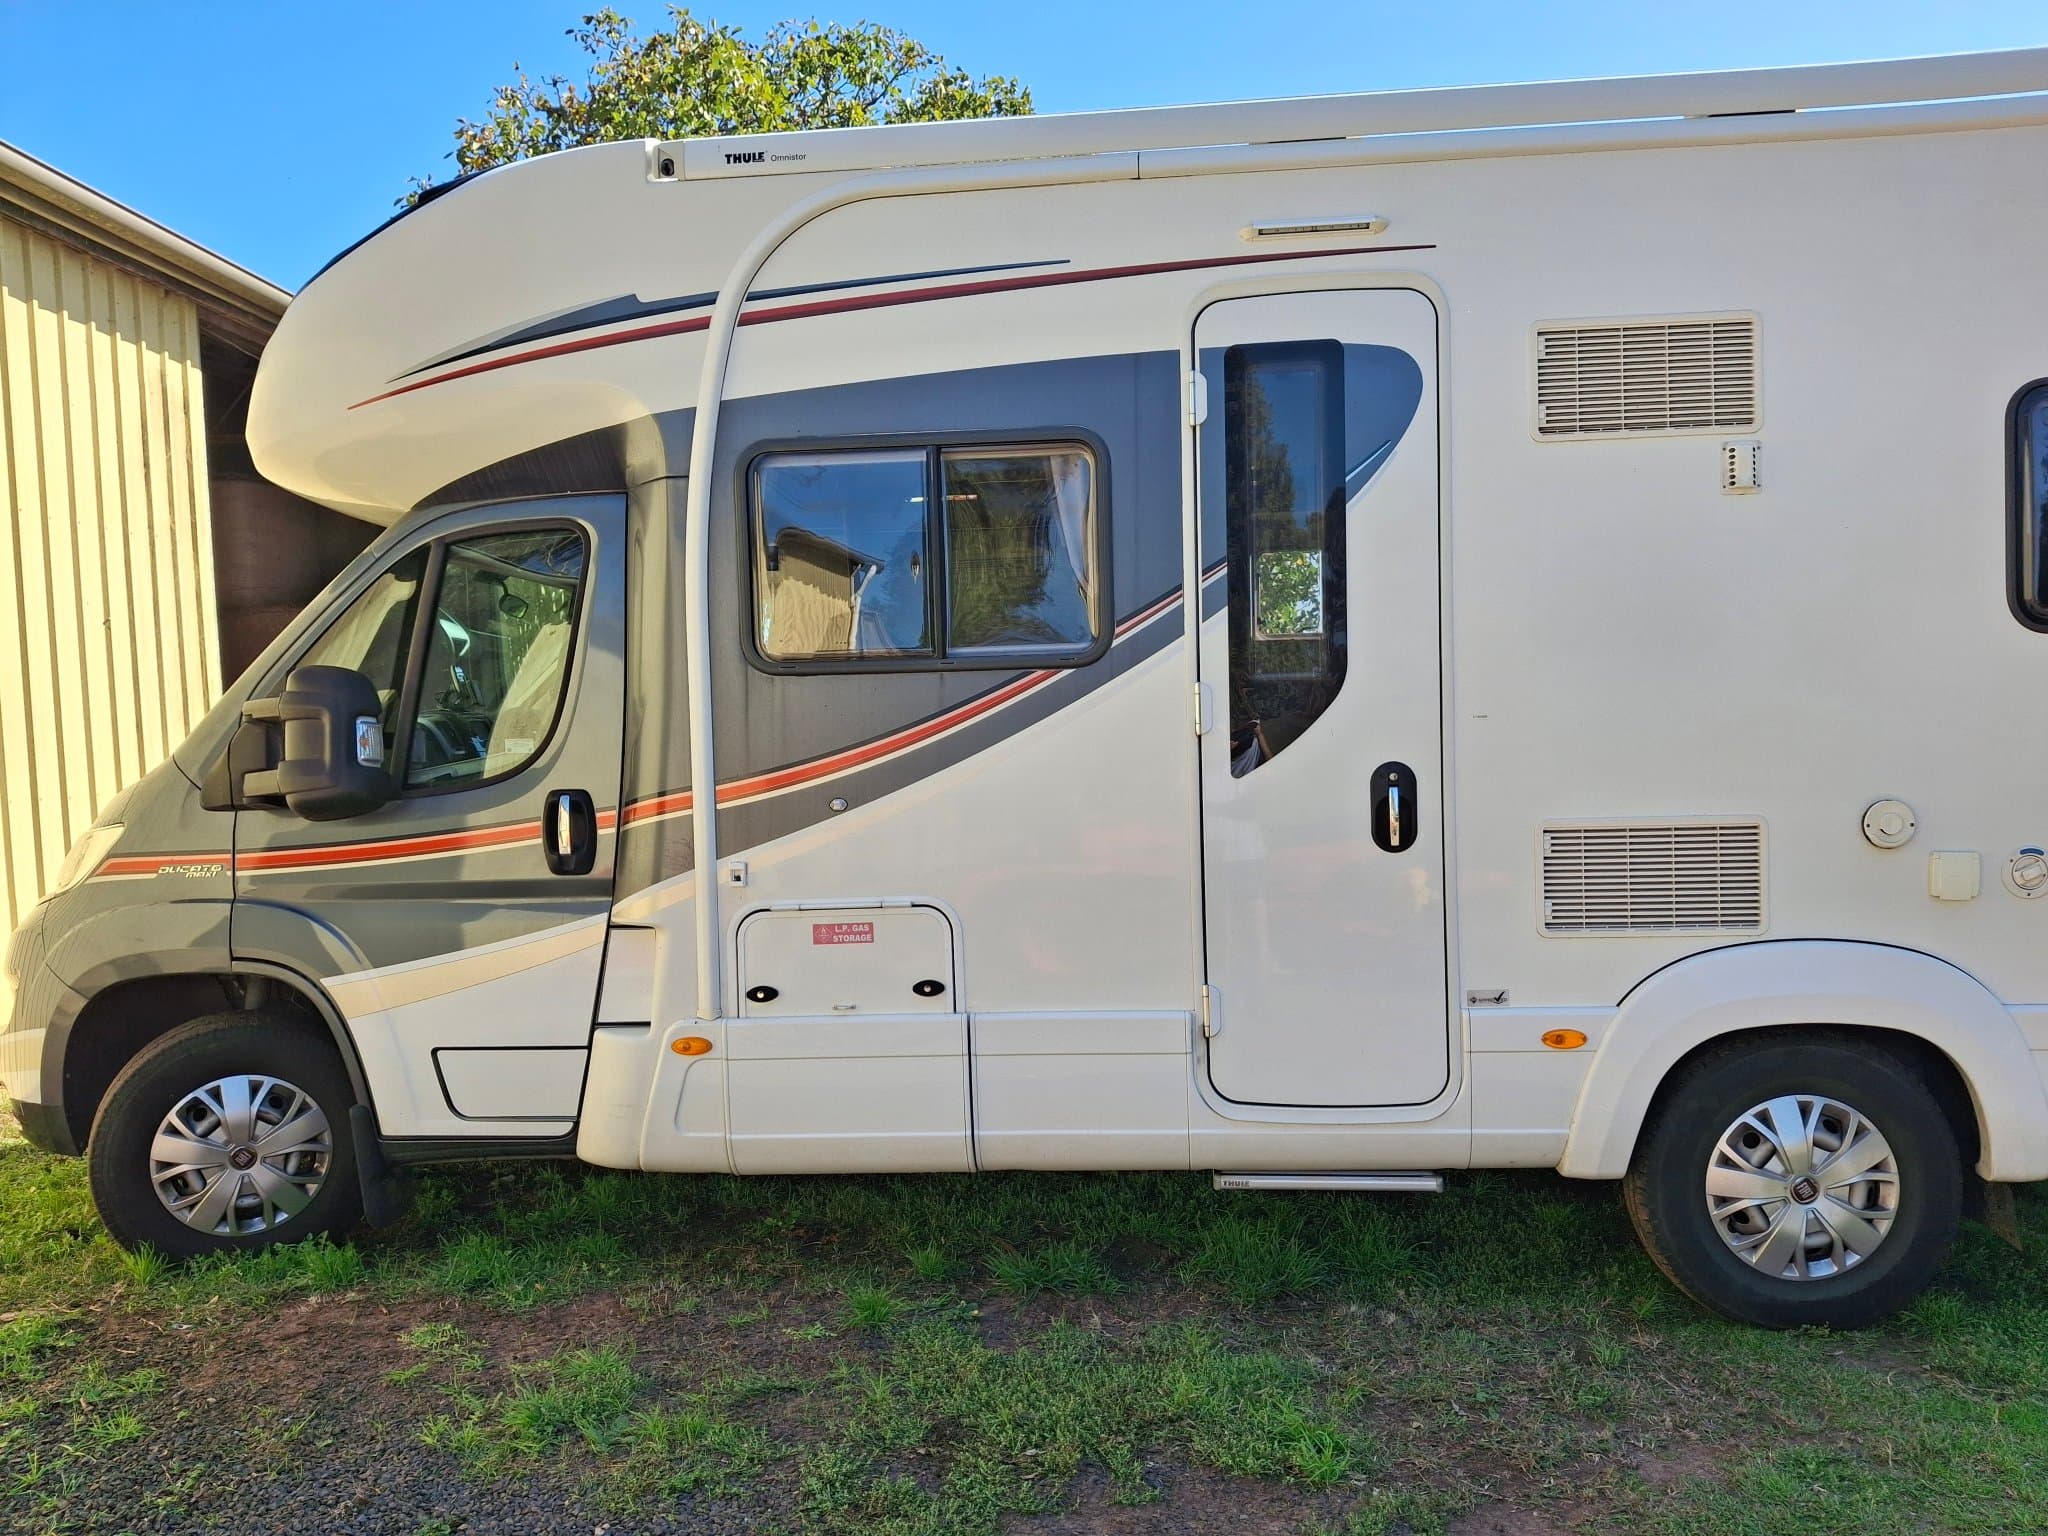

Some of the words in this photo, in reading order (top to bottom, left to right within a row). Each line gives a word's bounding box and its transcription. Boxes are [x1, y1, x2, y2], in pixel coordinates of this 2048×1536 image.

[725, 152, 765, 164] THULE
[770, 154, 806, 162] Omnistor
[158, 864, 222, 874] DUCATO
[852, 923, 870, 932] GAS
[832, 932, 873, 943] STORAGE
